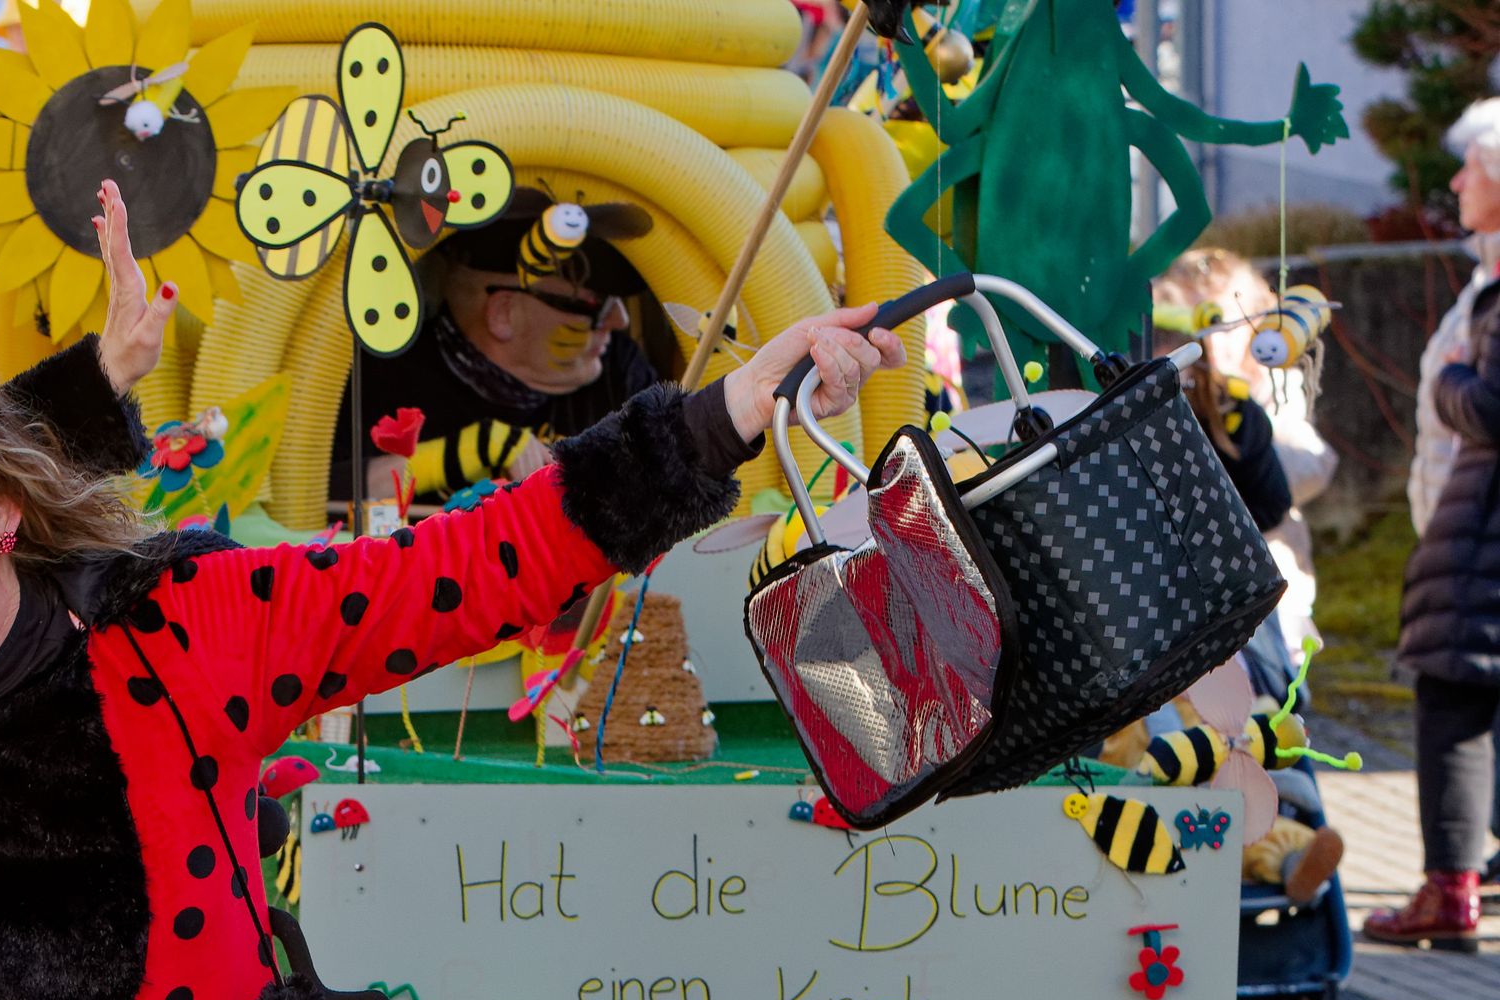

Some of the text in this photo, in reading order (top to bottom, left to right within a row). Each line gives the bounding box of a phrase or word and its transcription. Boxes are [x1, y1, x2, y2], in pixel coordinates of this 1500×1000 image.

[456, 833, 1089, 951] Hat die Blume
